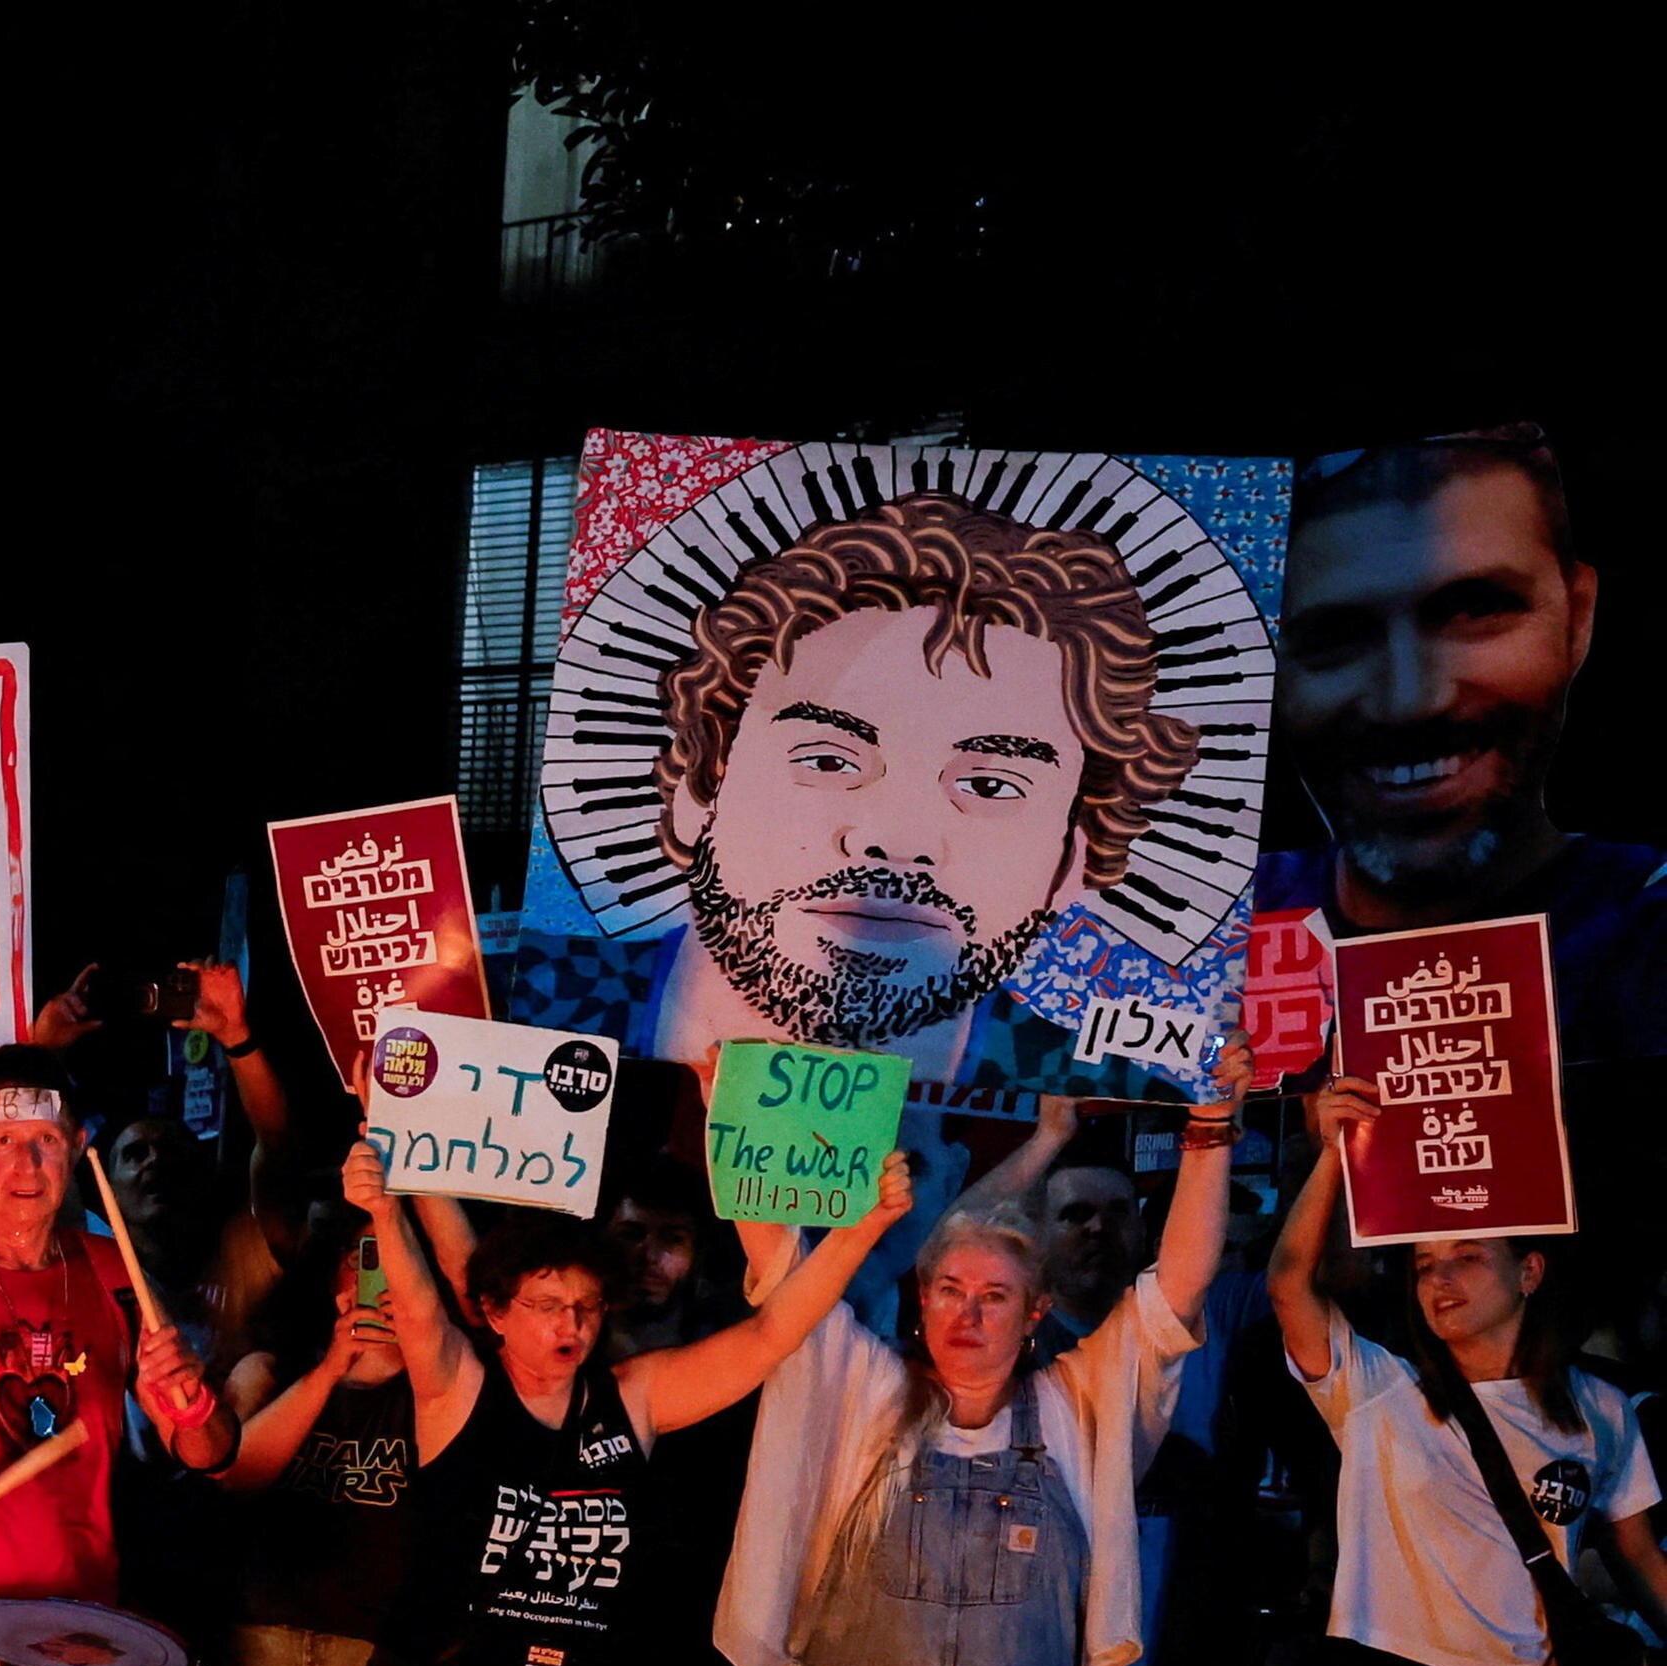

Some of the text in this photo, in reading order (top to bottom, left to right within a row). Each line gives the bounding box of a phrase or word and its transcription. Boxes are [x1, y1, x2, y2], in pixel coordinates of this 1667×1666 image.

[320, 832, 404, 876] نرفض
[310, 865, 425, 902] מסרבים
[326, 900, 420, 947] احتلال
[325, 933, 429, 971] לכיבוש
[357, 972, 406, 1012] غزة
[1386, 952, 1482, 998] نرفض
[1373, 989, 1503, 1026] מסרבים
[386, 1039, 428, 1057] עסקה
[1085, 1000, 1195, 1059] אלון
[1386, 1026, 1495, 1073] احتلال
[384, 1056, 426, 1075] מלאה
[758, 1050, 880, 1112] STOP
[1384, 1062, 1503, 1099] לכיבוש
[1423, 1102, 1478, 1143] غزة
[709, 1122, 775, 1174] The
[1423, 1141, 1484, 1168] עזה
[497, 1484, 627, 1522] מסתכלים
